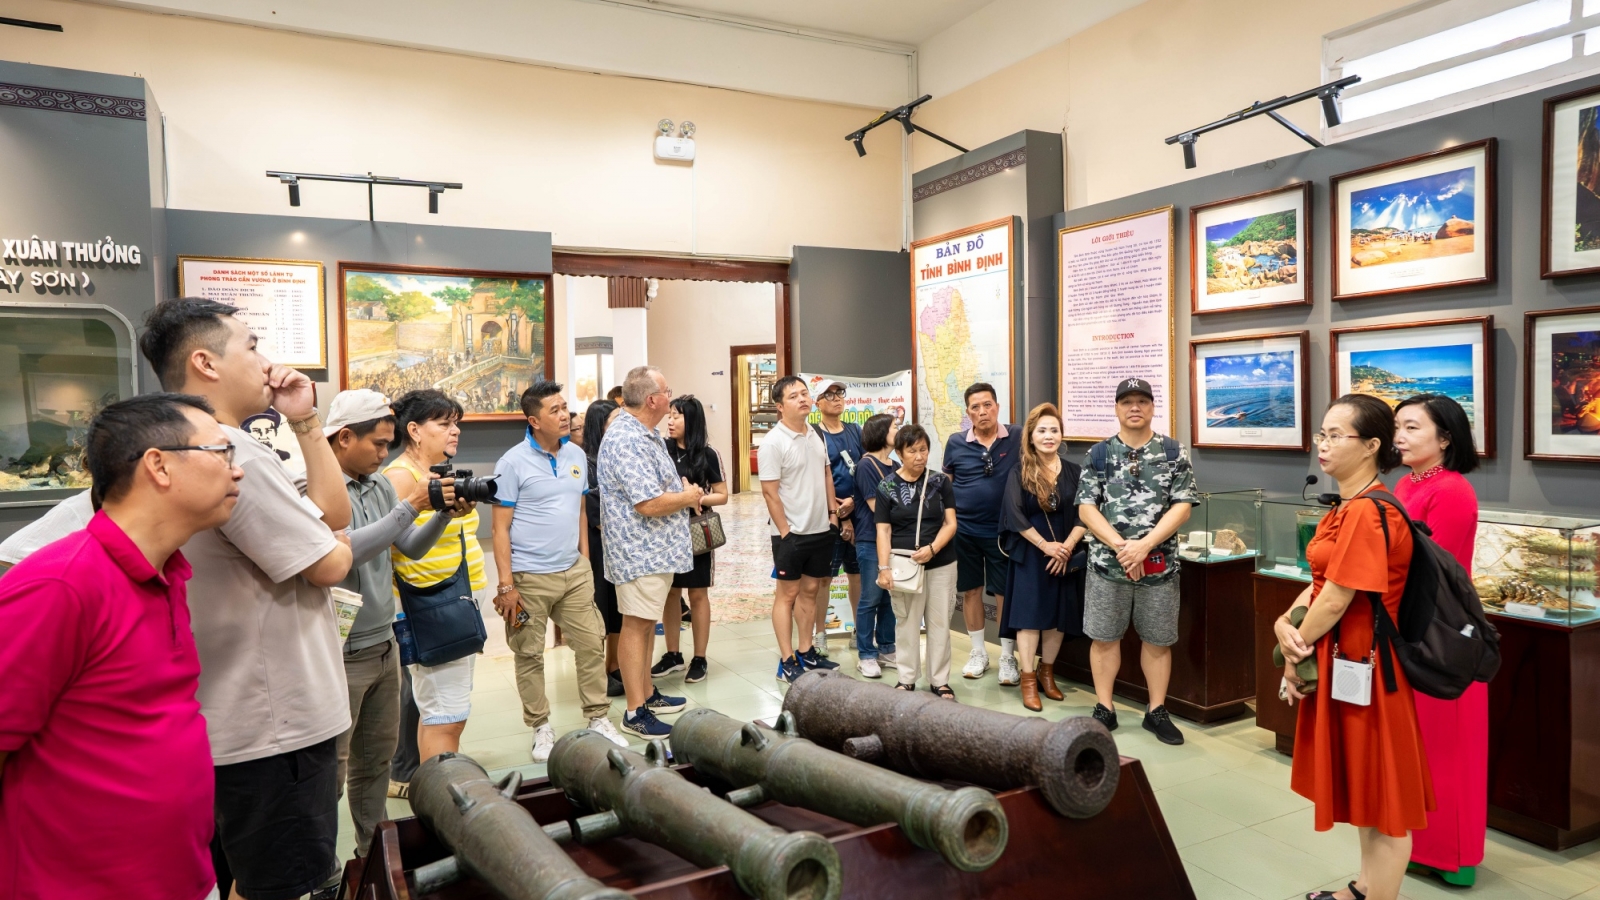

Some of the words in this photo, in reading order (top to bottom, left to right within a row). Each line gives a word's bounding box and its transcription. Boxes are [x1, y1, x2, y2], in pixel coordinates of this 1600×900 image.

[2, 234, 57, 260] XUÂN
[62, 235, 141, 264] THƯỞNG
[936, 242, 960, 258] BẢN
[967, 233, 984, 252] ĐỒ
[921, 264, 942, 280] TỈNH
[947, 259, 971, 275] BÌNH
[977, 252, 1003, 271] ĐỊNH
[30, 270, 76, 287] SƠN
[1092, 332, 1134, 342] INTRODUCTION
[808, 409, 822, 424] ĐÊ
